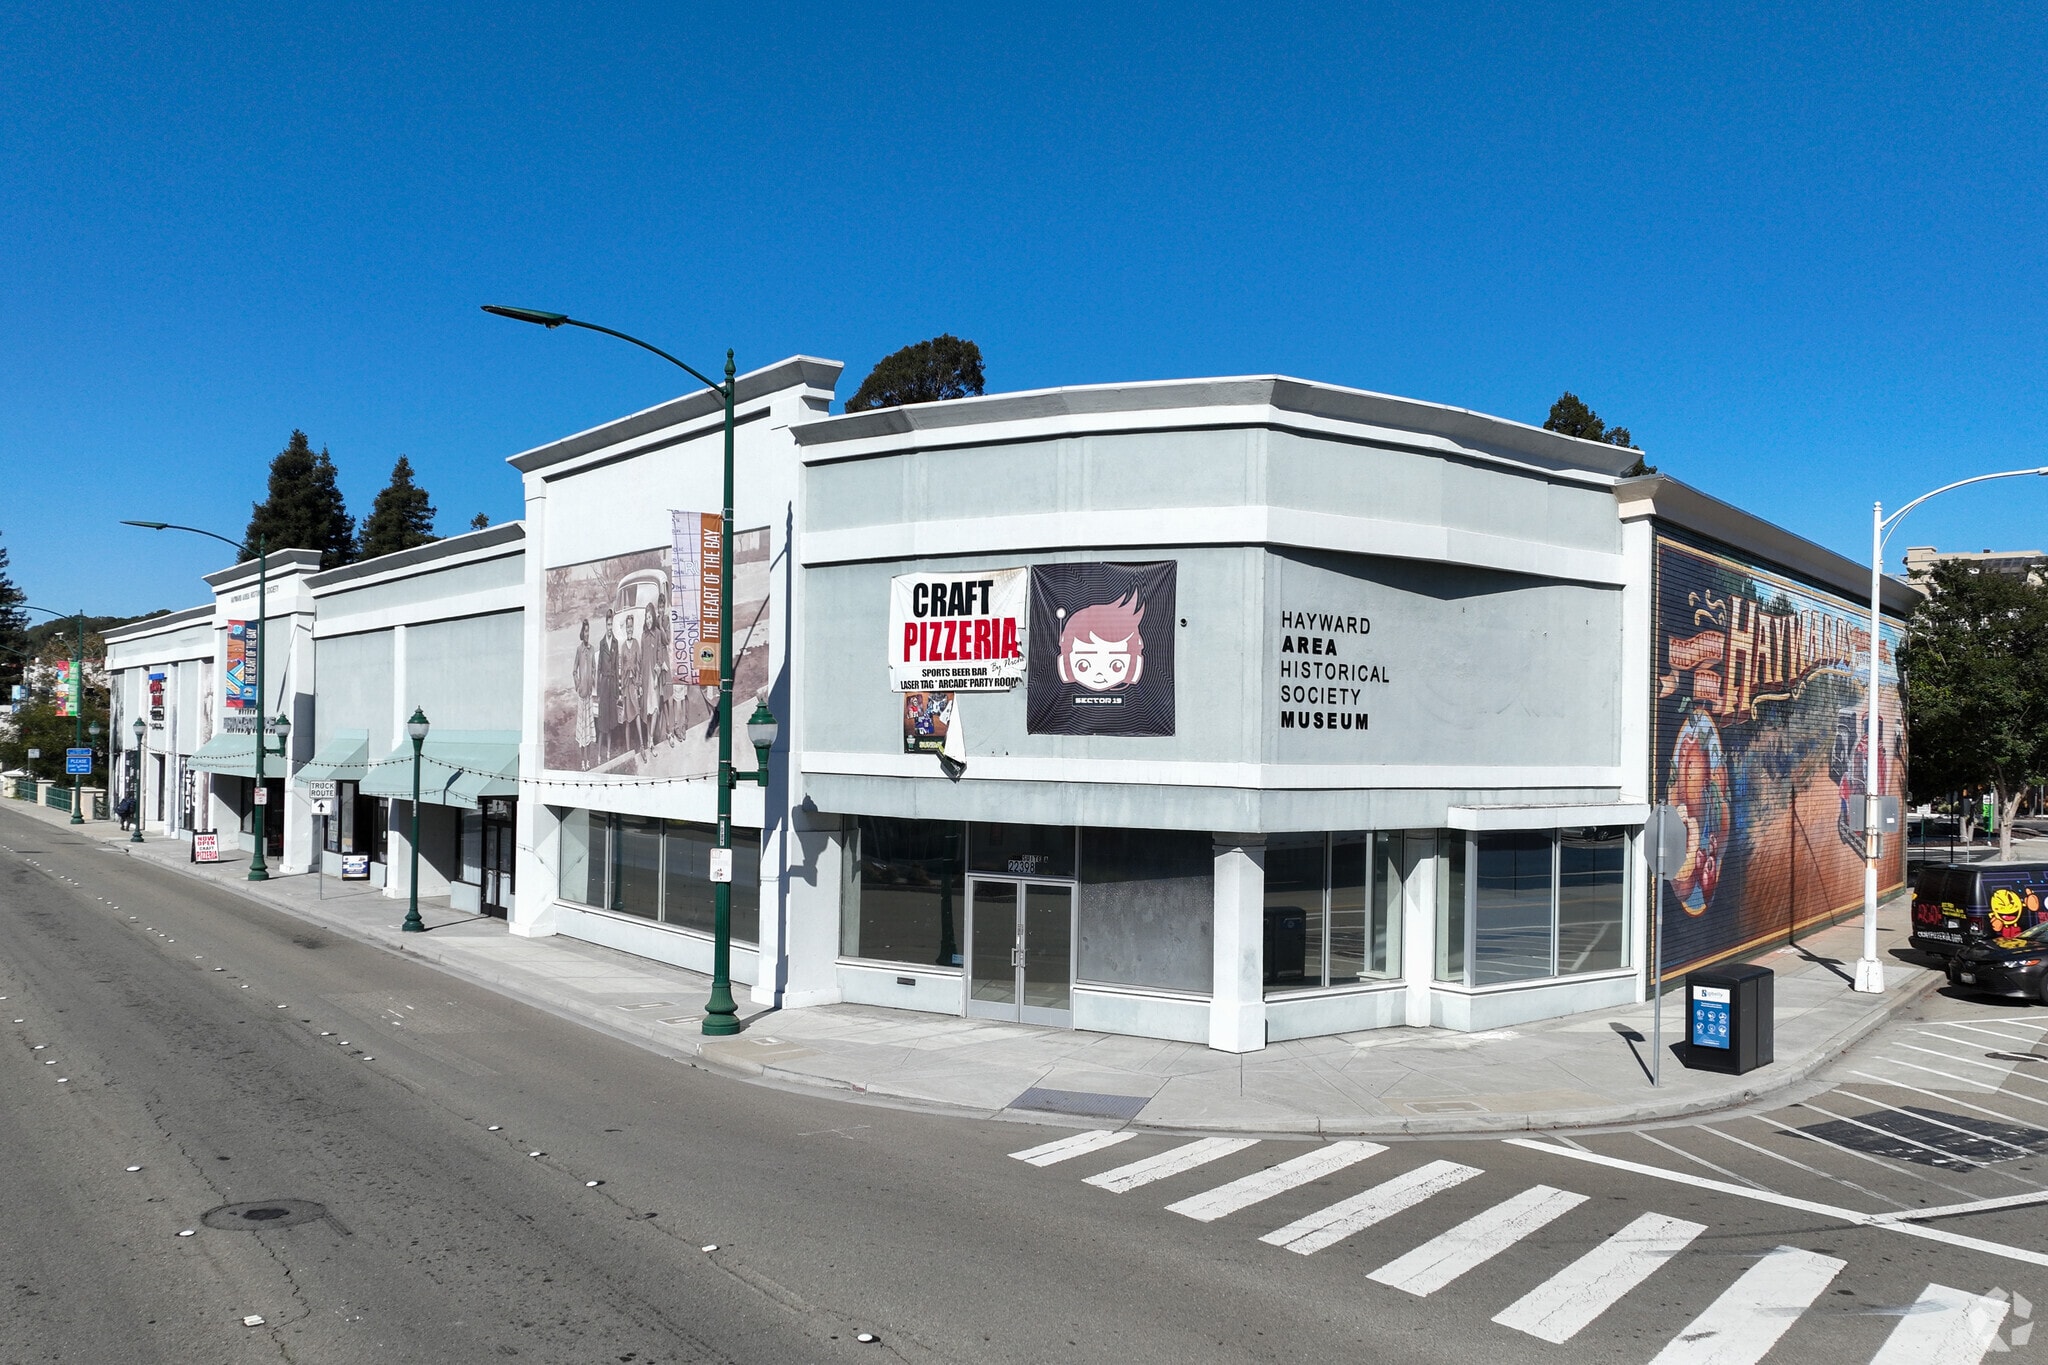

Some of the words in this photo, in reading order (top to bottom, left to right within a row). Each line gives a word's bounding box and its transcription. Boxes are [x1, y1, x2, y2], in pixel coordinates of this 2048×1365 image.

[704, 528, 720, 549] BAY
[703, 550, 720, 569] THE
[703, 572, 719, 584] OF
[703, 587, 719, 618] HEART
[913, 580, 993, 618] CRAFT
[703, 621, 719, 639] THE
[1282, 610, 1371, 634] HAYWARD
[246, 628, 257, 639] BAY
[904, 617, 1020, 662] PIZZERIA
[246, 639, 256, 649] THE
[246, 649, 256, 657] OF
[1282, 635, 1337, 656] AREA
[245, 657, 256, 674] HEART
[922, 668, 950, 677] SPORTS
[952, 668, 971, 677] BEER
[972, 667, 988, 676] BAR
[1281, 660, 1390, 683] HISTORICAL
[245, 675, 256, 684] THE
[900, 680, 919, 690] LASER
[920, 680, 934, 689] TAG
[938, 679, 968, 689] ARCADE
[968, 678, 994, 688] PARTY
[1281, 685, 1361, 706] SOCIETY
[1281, 711, 1369, 730] MUSEUM
[196, 851, 218, 860] PIZZERIA
[1009, 860, 1035, 873] 22398
